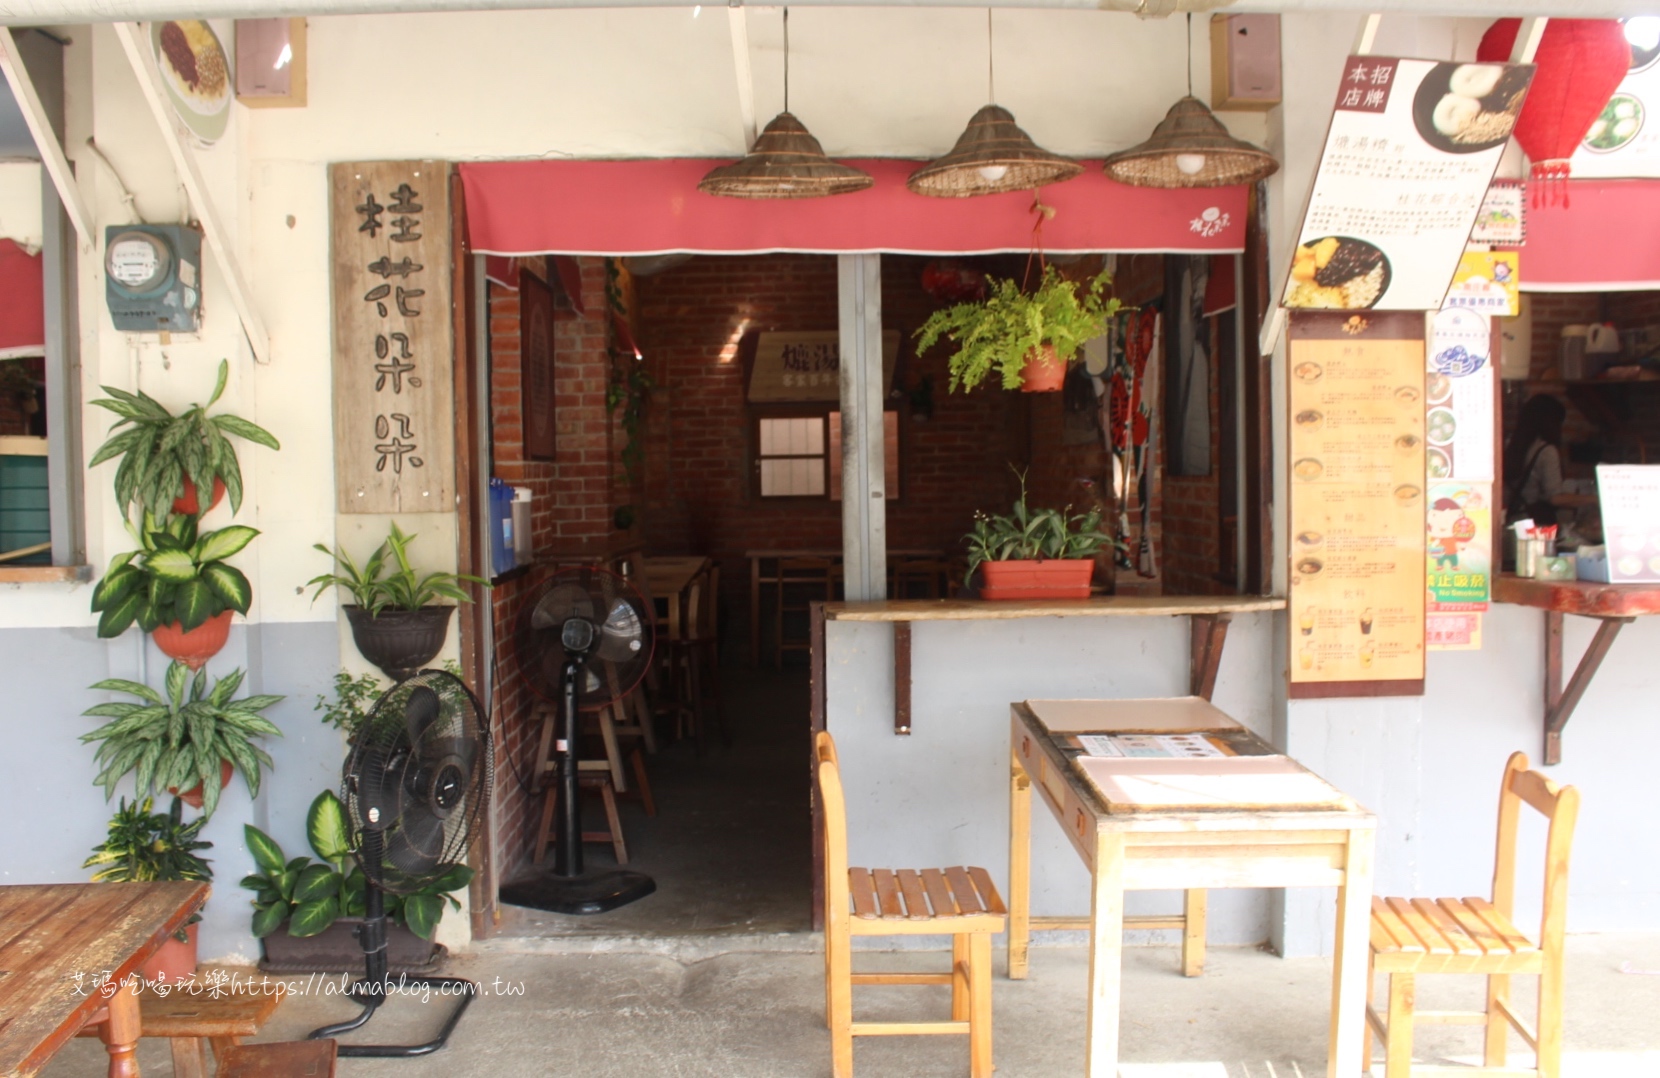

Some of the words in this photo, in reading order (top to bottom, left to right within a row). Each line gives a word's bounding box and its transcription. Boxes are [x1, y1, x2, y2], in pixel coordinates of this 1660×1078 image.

[355, 182, 425, 475] 桂花朵朵
[1439, 588, 1450, 597] No
[1451, 588, 1486, 598] Smoking
